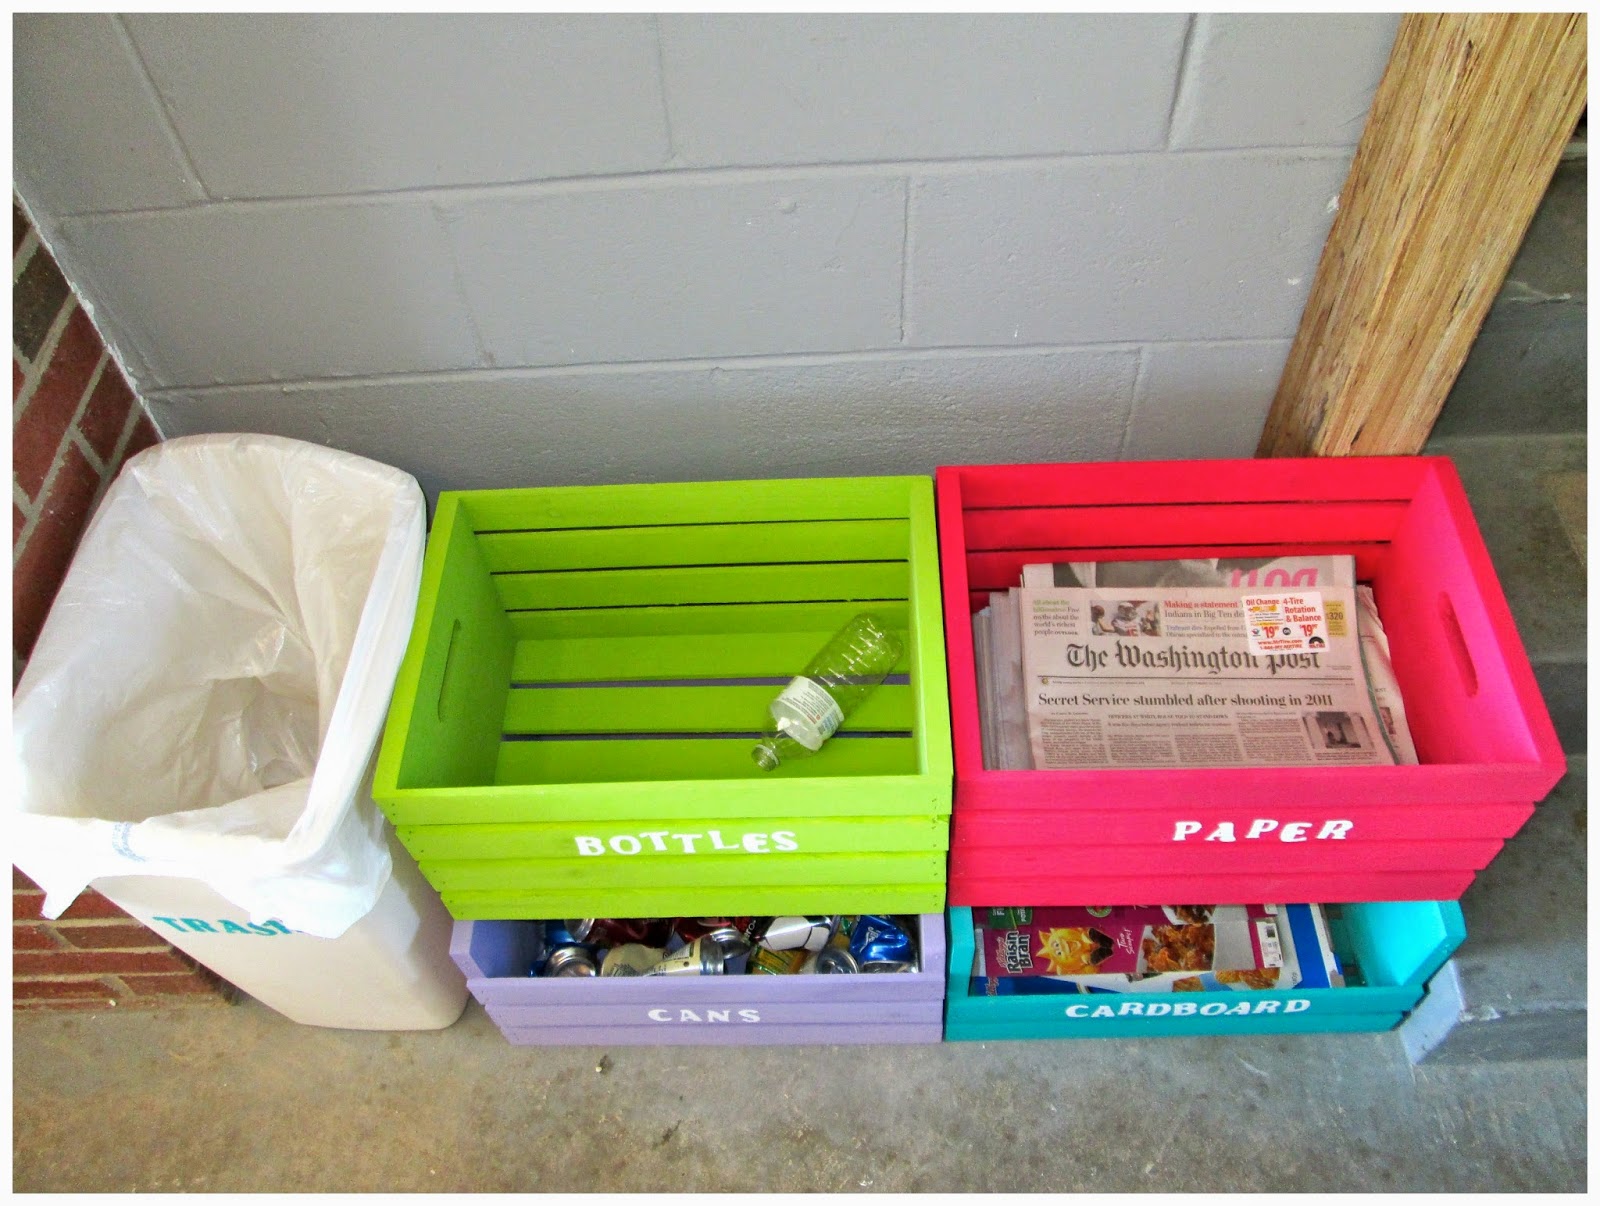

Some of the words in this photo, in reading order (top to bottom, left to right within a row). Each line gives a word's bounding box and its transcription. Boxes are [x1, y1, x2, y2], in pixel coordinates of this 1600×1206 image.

[1164, 600, 1193, 609] Making
[1283, 597, 1304, 605] 4-Tire
[1164, 610, 1193, 618] Indiana
[1194, 610, 1202, 618] in
[1203, 610, 1216, 619] Big
[1217, 610, 1233, 618] Ten
[1284, 606, 1316, 614] Rotation
[1285, 615, 1292, 623] &
[1293, 614, 1322, 622] Balance
[1066, 643, 1108, 672] The
[1115, 640, 1259, 676] Washington
[1038, 693, 1079, 706] Secret
[1082, 693, 1130, 706] Service
[1133, 693, 1194, 706] stumbled
[1197, 694, 1227, 706] after
[1231, 694, 1287, 709] shooting
[1290, 694, 1302, 706] in
[1304, 694, 1333, 706] 2011
[1172, 818, 1354, 843] PAPER
[574, 830, 799, 856] BOTTLES
[1006, 931, 1022, 973] Raisin
[1018, 935, 1033, 968] Bran
[647, 1008, 762, 1024] CANS
[1065, 998, 1311, 1020] CARDBOARD
